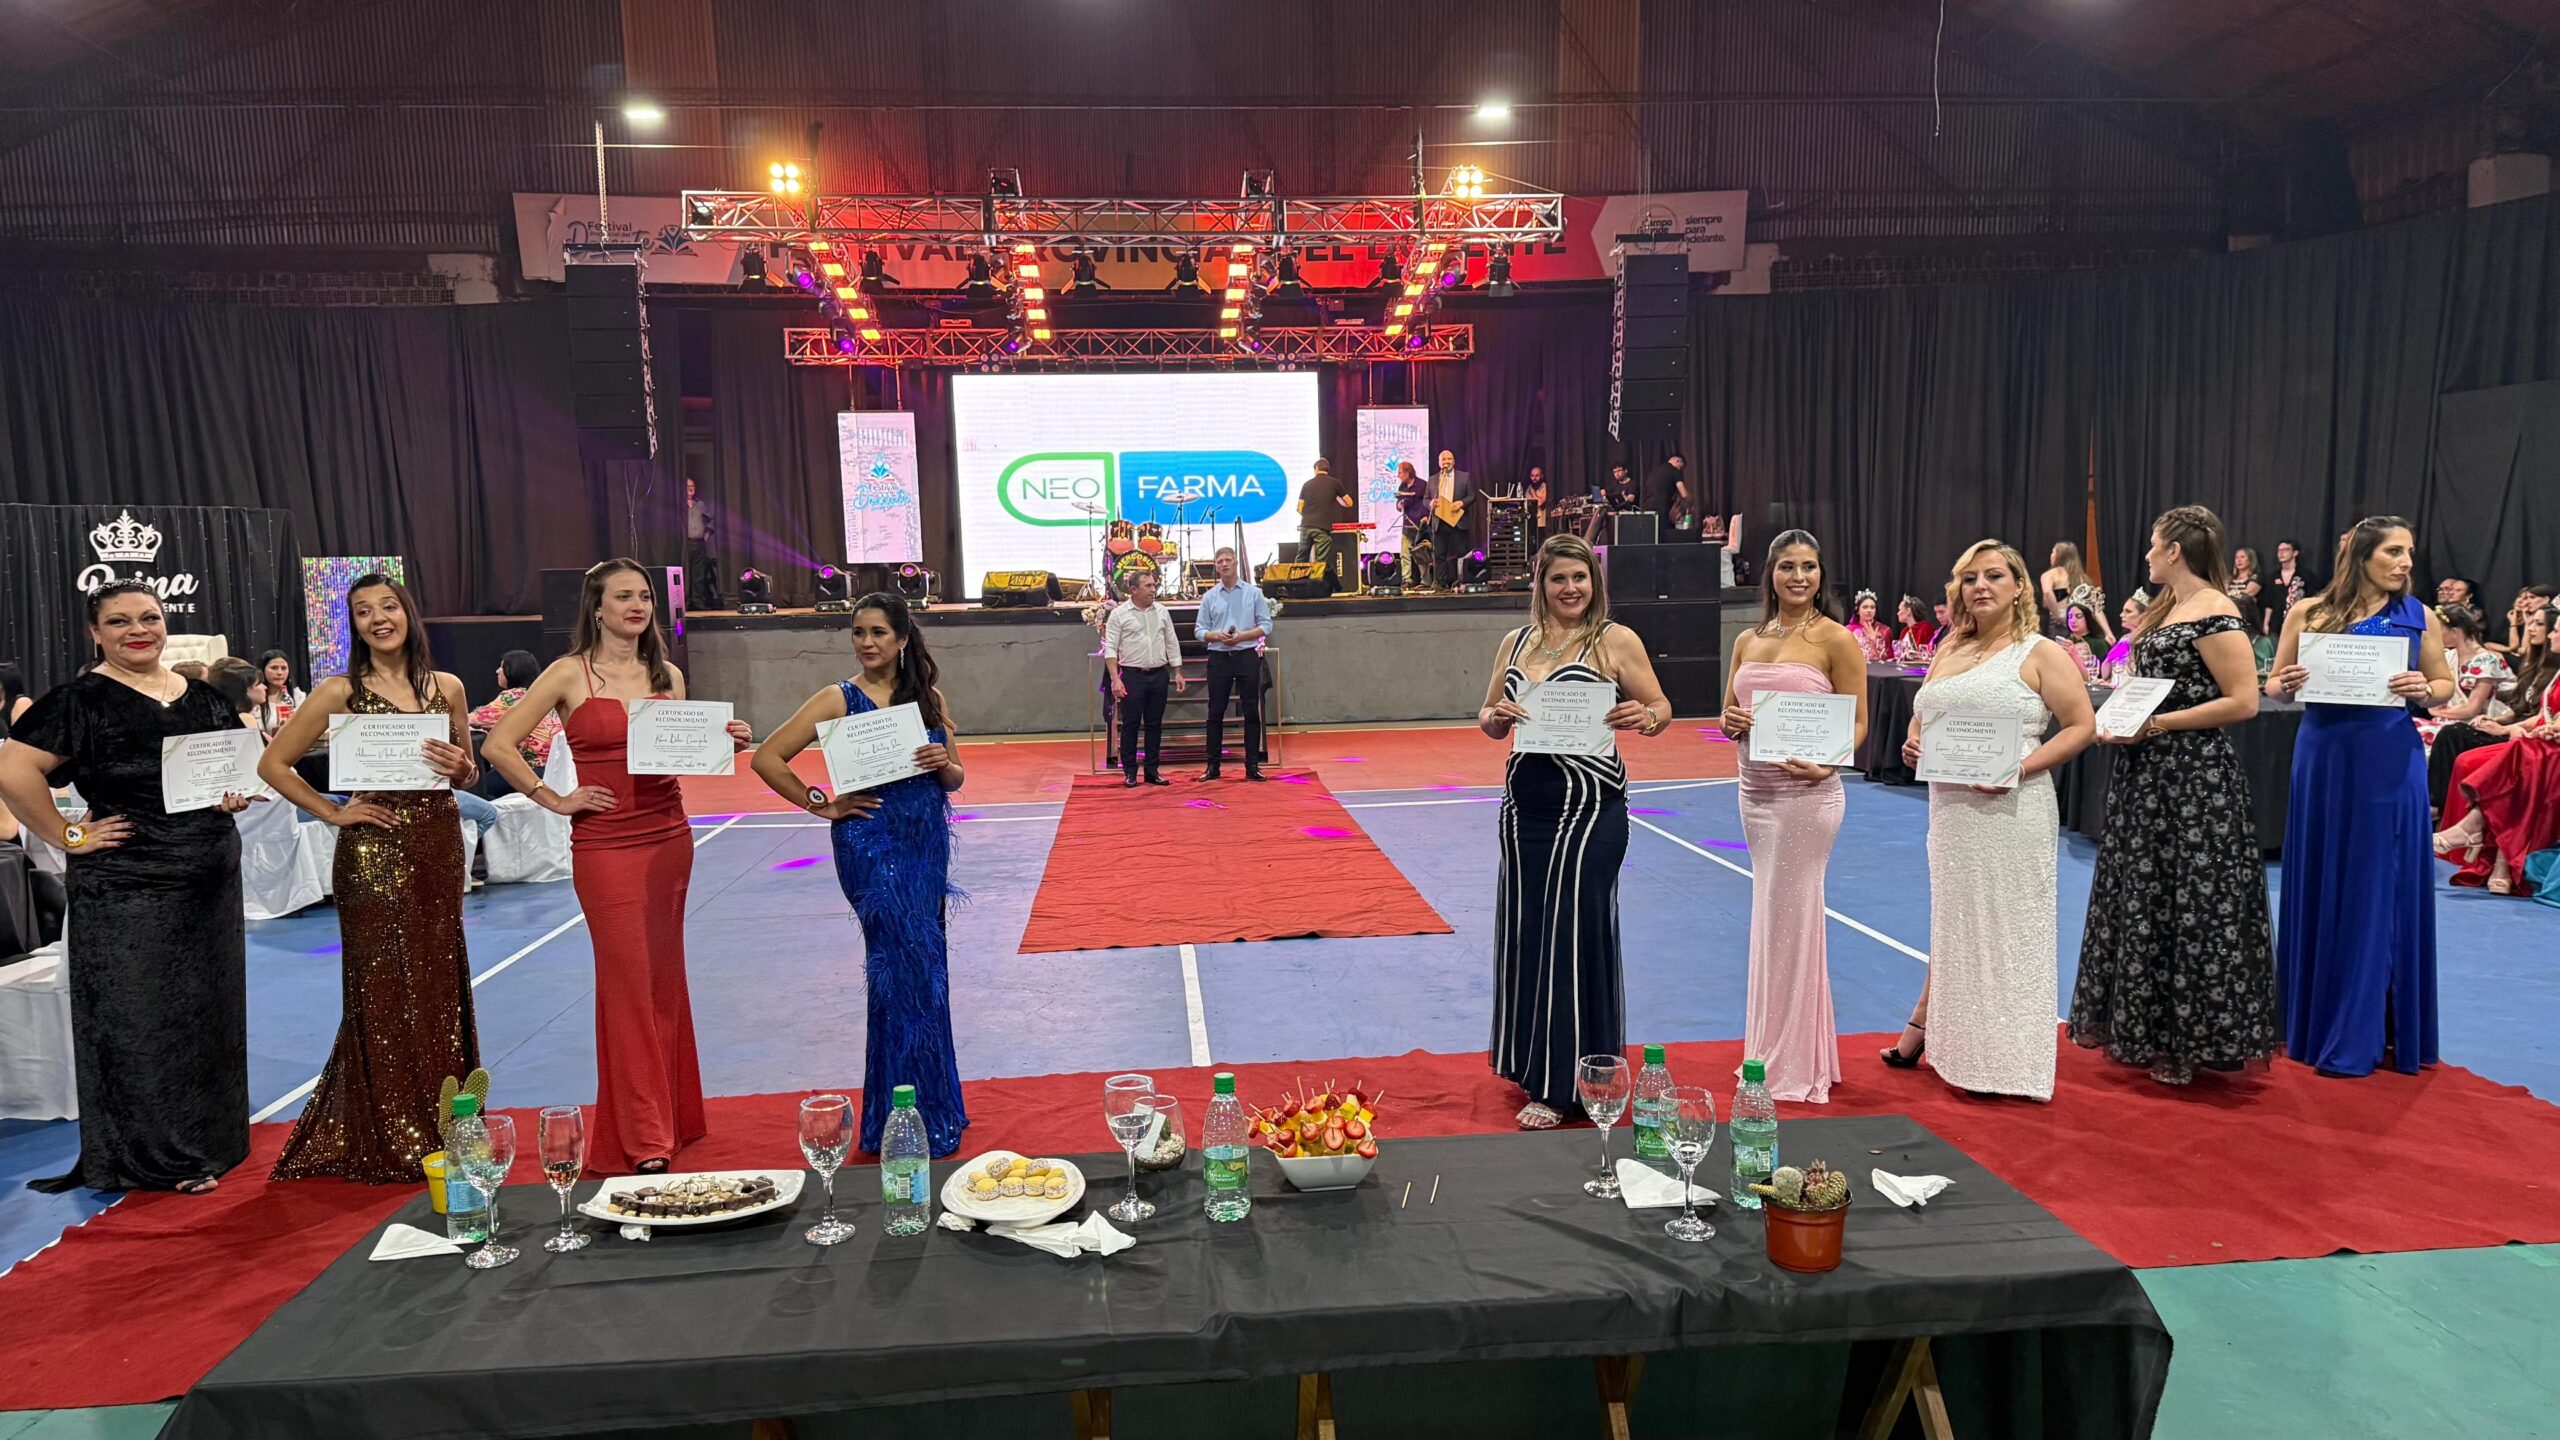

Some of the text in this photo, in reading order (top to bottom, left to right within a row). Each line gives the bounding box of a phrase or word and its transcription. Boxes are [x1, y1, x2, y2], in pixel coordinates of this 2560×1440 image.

[1685, 215, 1722, 225] siempre
[587, 221, 632, 231] Fetival
[1684, 225, 1706, 234] para
[1022, 474, 1266, 500] NEO FARMA
[846, 722, 898, 738] RECONOCIMIENTO
[848, 719, 884, 731] CERTIFICADO
[189, 742, 225, 750] CERTIFICADO
[186, 746, 236, 757] RECONOCIMIENTO
[812, 792, 822, 801] 6
